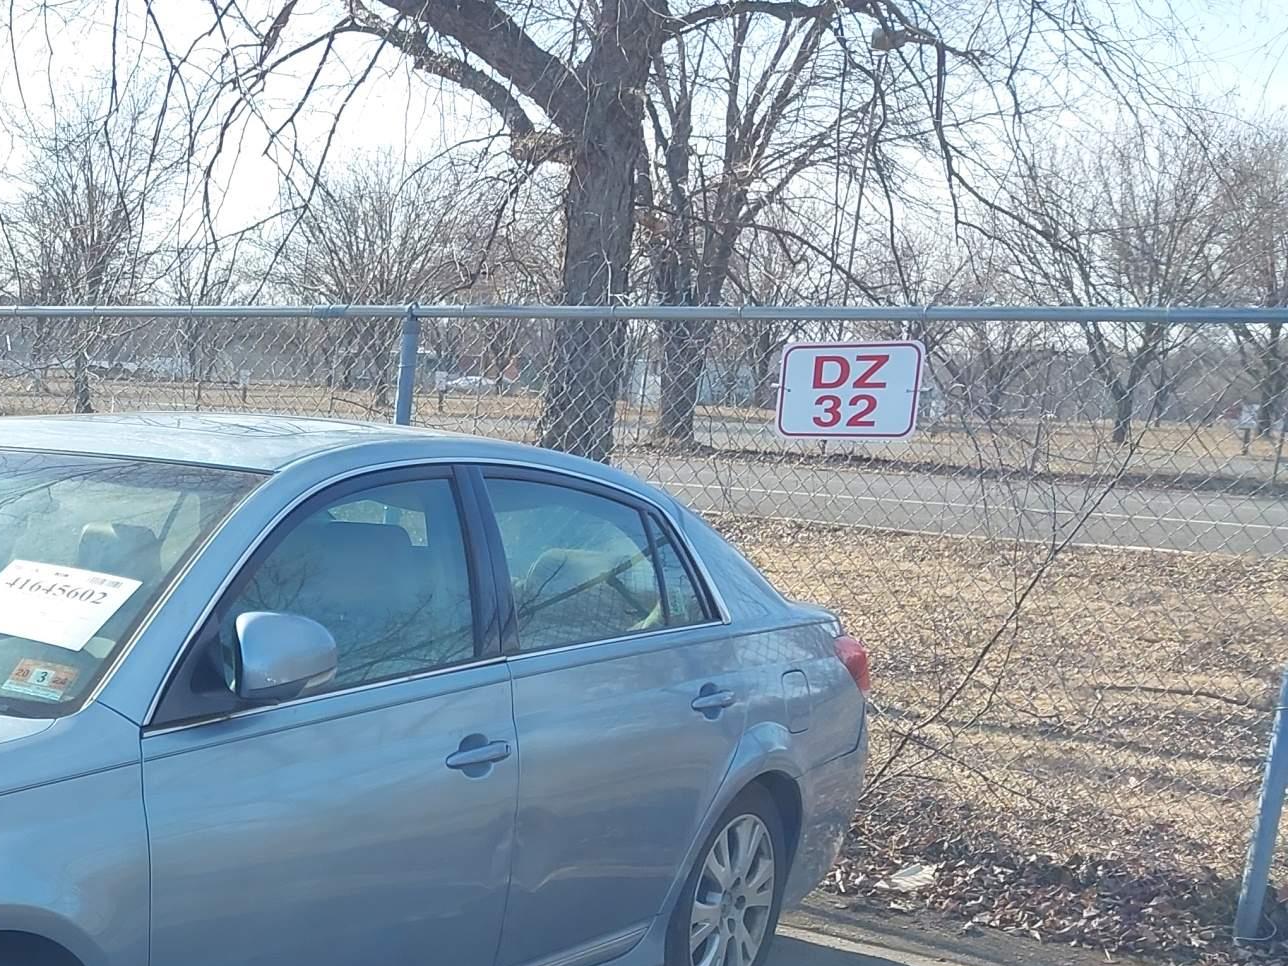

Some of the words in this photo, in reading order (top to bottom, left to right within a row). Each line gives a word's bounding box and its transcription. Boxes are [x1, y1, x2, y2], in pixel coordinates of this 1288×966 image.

[812, 355, 890, 389] DZ
[812, 394, 877, 428] 32
[5, 577, 107, 605] 41645602
[37, 671, 49, 683] 3
